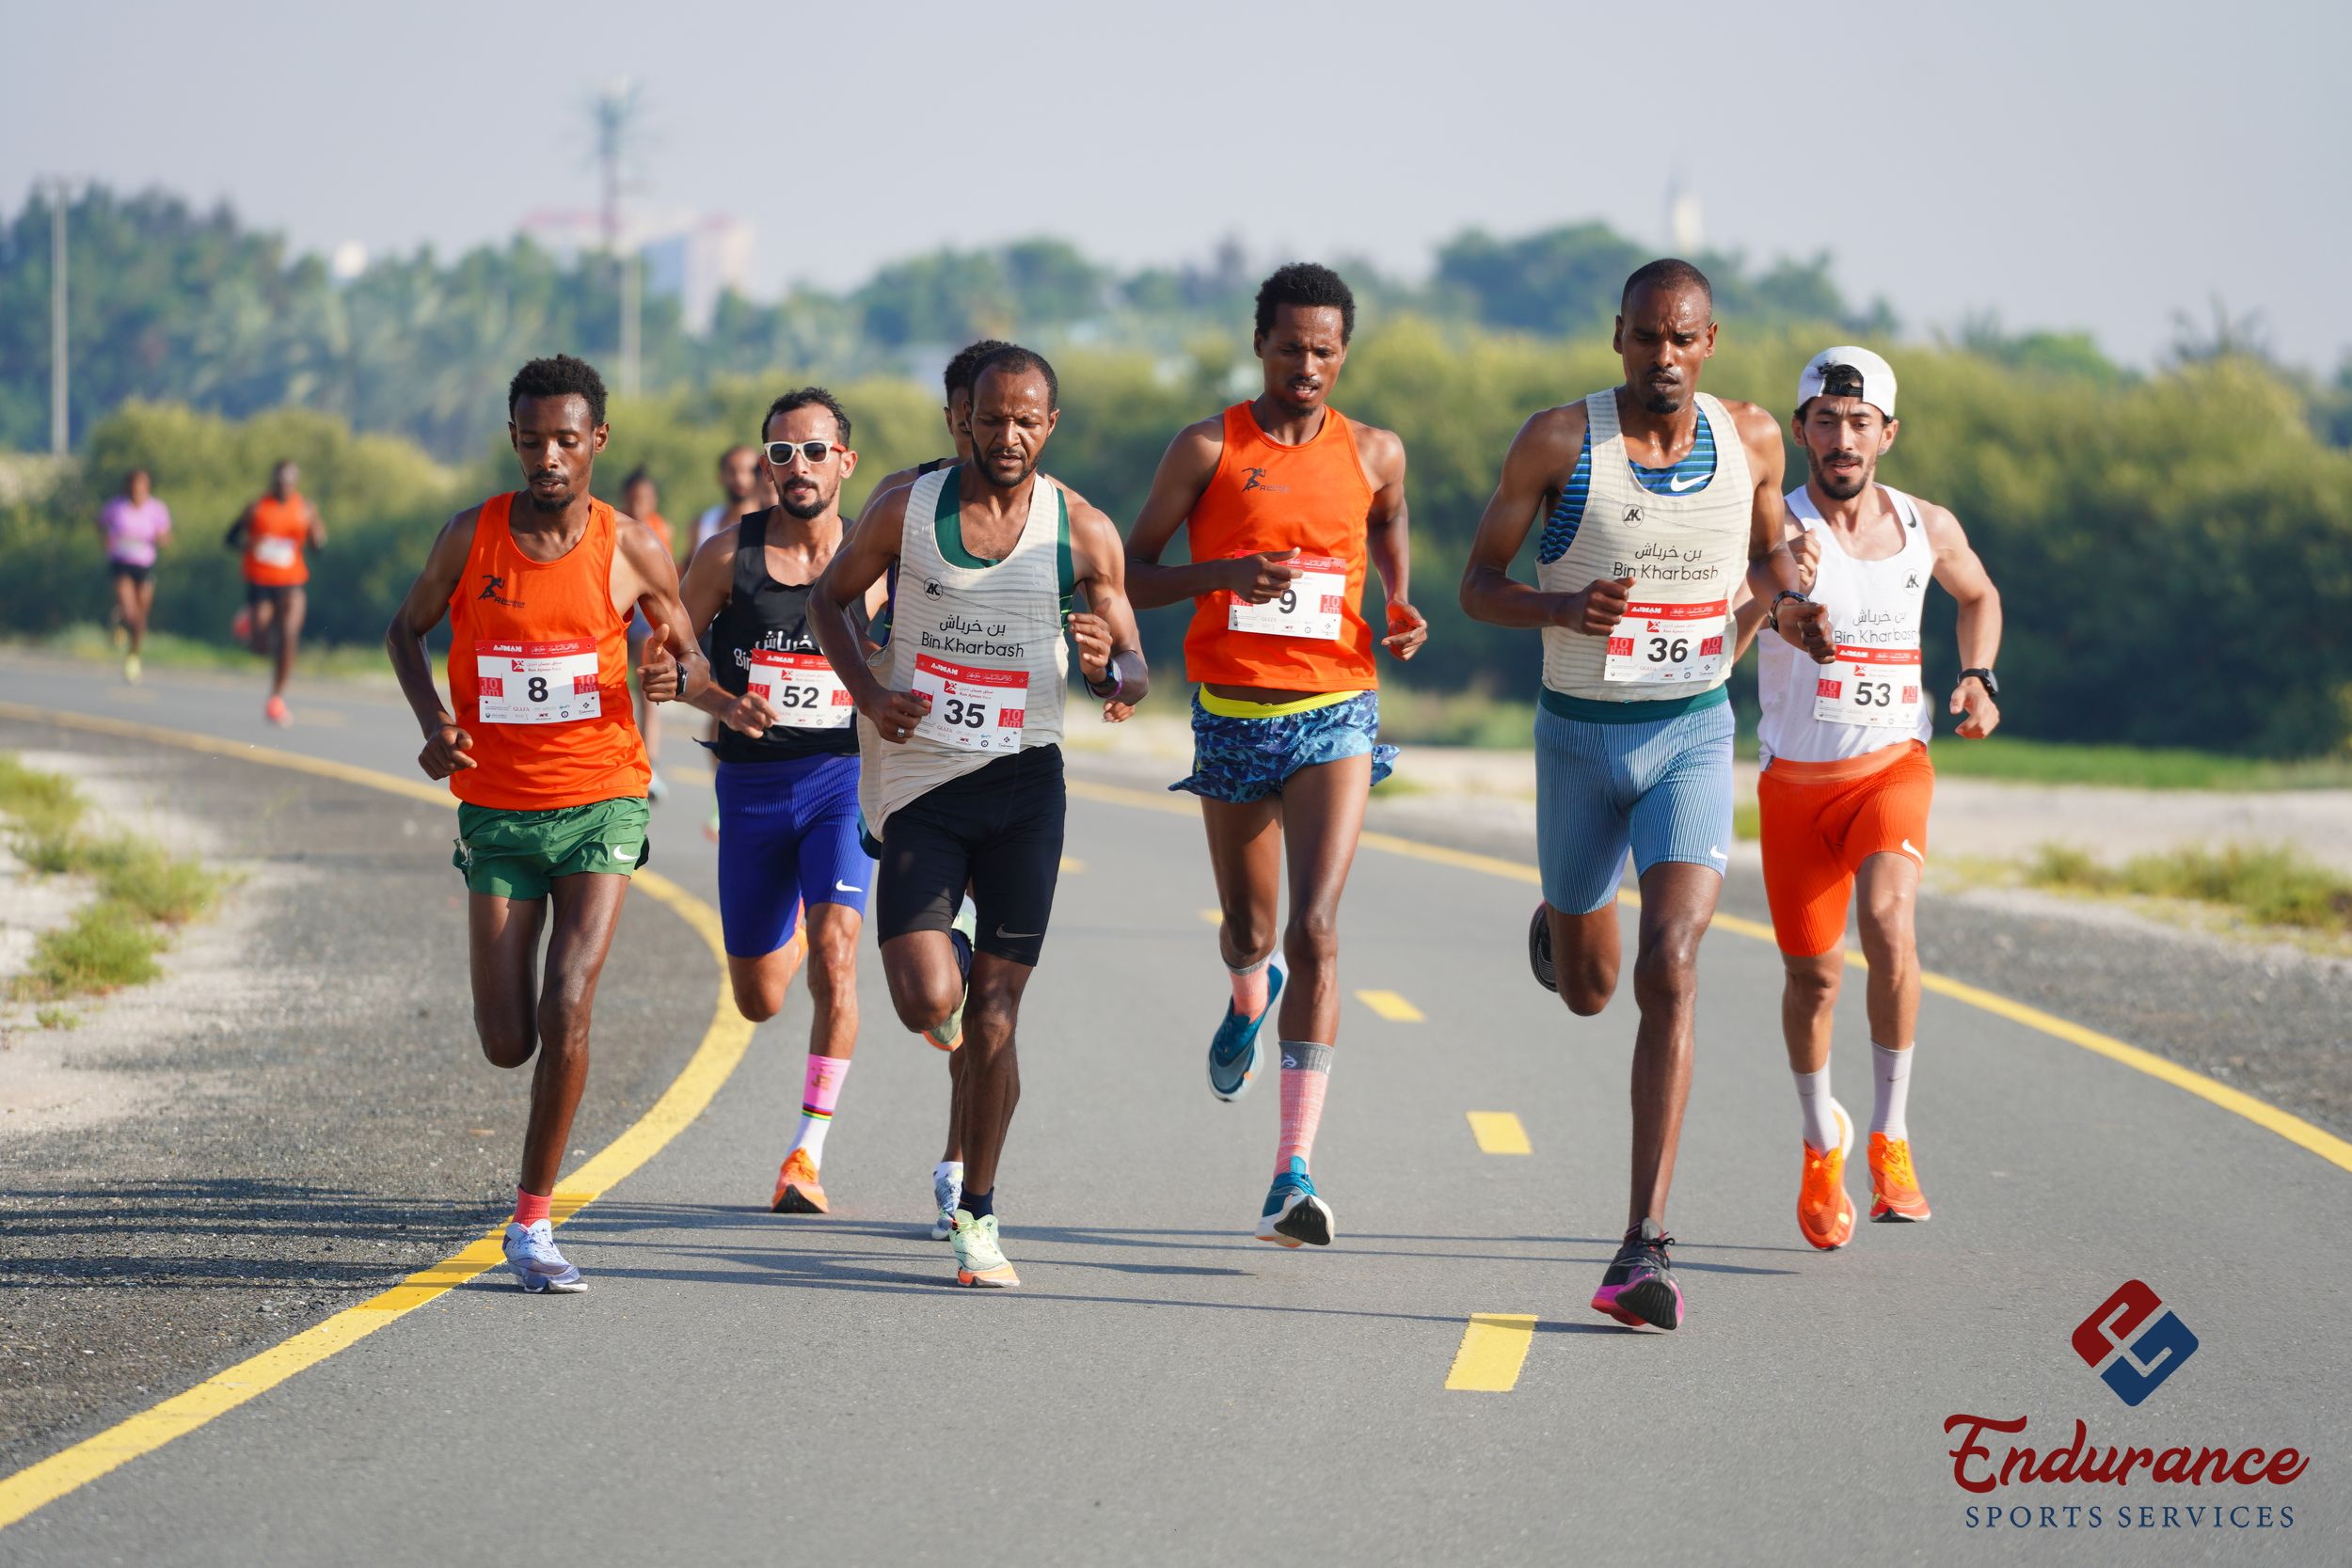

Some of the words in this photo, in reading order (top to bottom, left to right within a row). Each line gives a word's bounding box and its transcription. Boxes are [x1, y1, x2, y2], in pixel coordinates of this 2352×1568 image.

[1635, 543, 1679, 561] خرباش
[1683, 549, 1702, 562] بن
[1613, 562, 1636, 578] Bin
[1641, 564, 1719, 580] Kharbash
[1279, 589, 1296, 613] 9
[1324, 595, 1340, 606] 10
[1323, 604, 1340, 614] km
[1852, 610, 1891, 626] خرباش
[940, 614, 983, 635] خرباش
[988, 624, 1006, 637] بن
[1835, 630, 1855, 644] Bin
[1859, 628, 1917, 643] Kharbash
[493, 644, 522, 653] AJMAN
[921, 631, 941, 650] Bin
[944, 636, 1025, 657] Kharbash
[1613, 638, 1629, 649] 10
[1705, 637, 1720, 648] 10
[1610, 647, 1629, 656] km
[1647, 637, 1689, 662] 36
[1703, 645, 1720, 655] km
[930, 662, 959, 675] AJMAN
[481, 678, 499, 689] 10
[579, 674, 596, 685] 10
[1820, 679, 1837, 691] 10
[481, 688, 500, 696] km
[528, 676, 548, 703] 8
[579, 683, 596, 693] km
[1818, 689, 1836, 698] km
[1854, 681, 1891, 707] 53
[782, 685, 819, 709] 52
[944, 699, 986, 729] 35
[1005, 710, 1021, 720] 10
[1003, 719, 1020, 728] km
